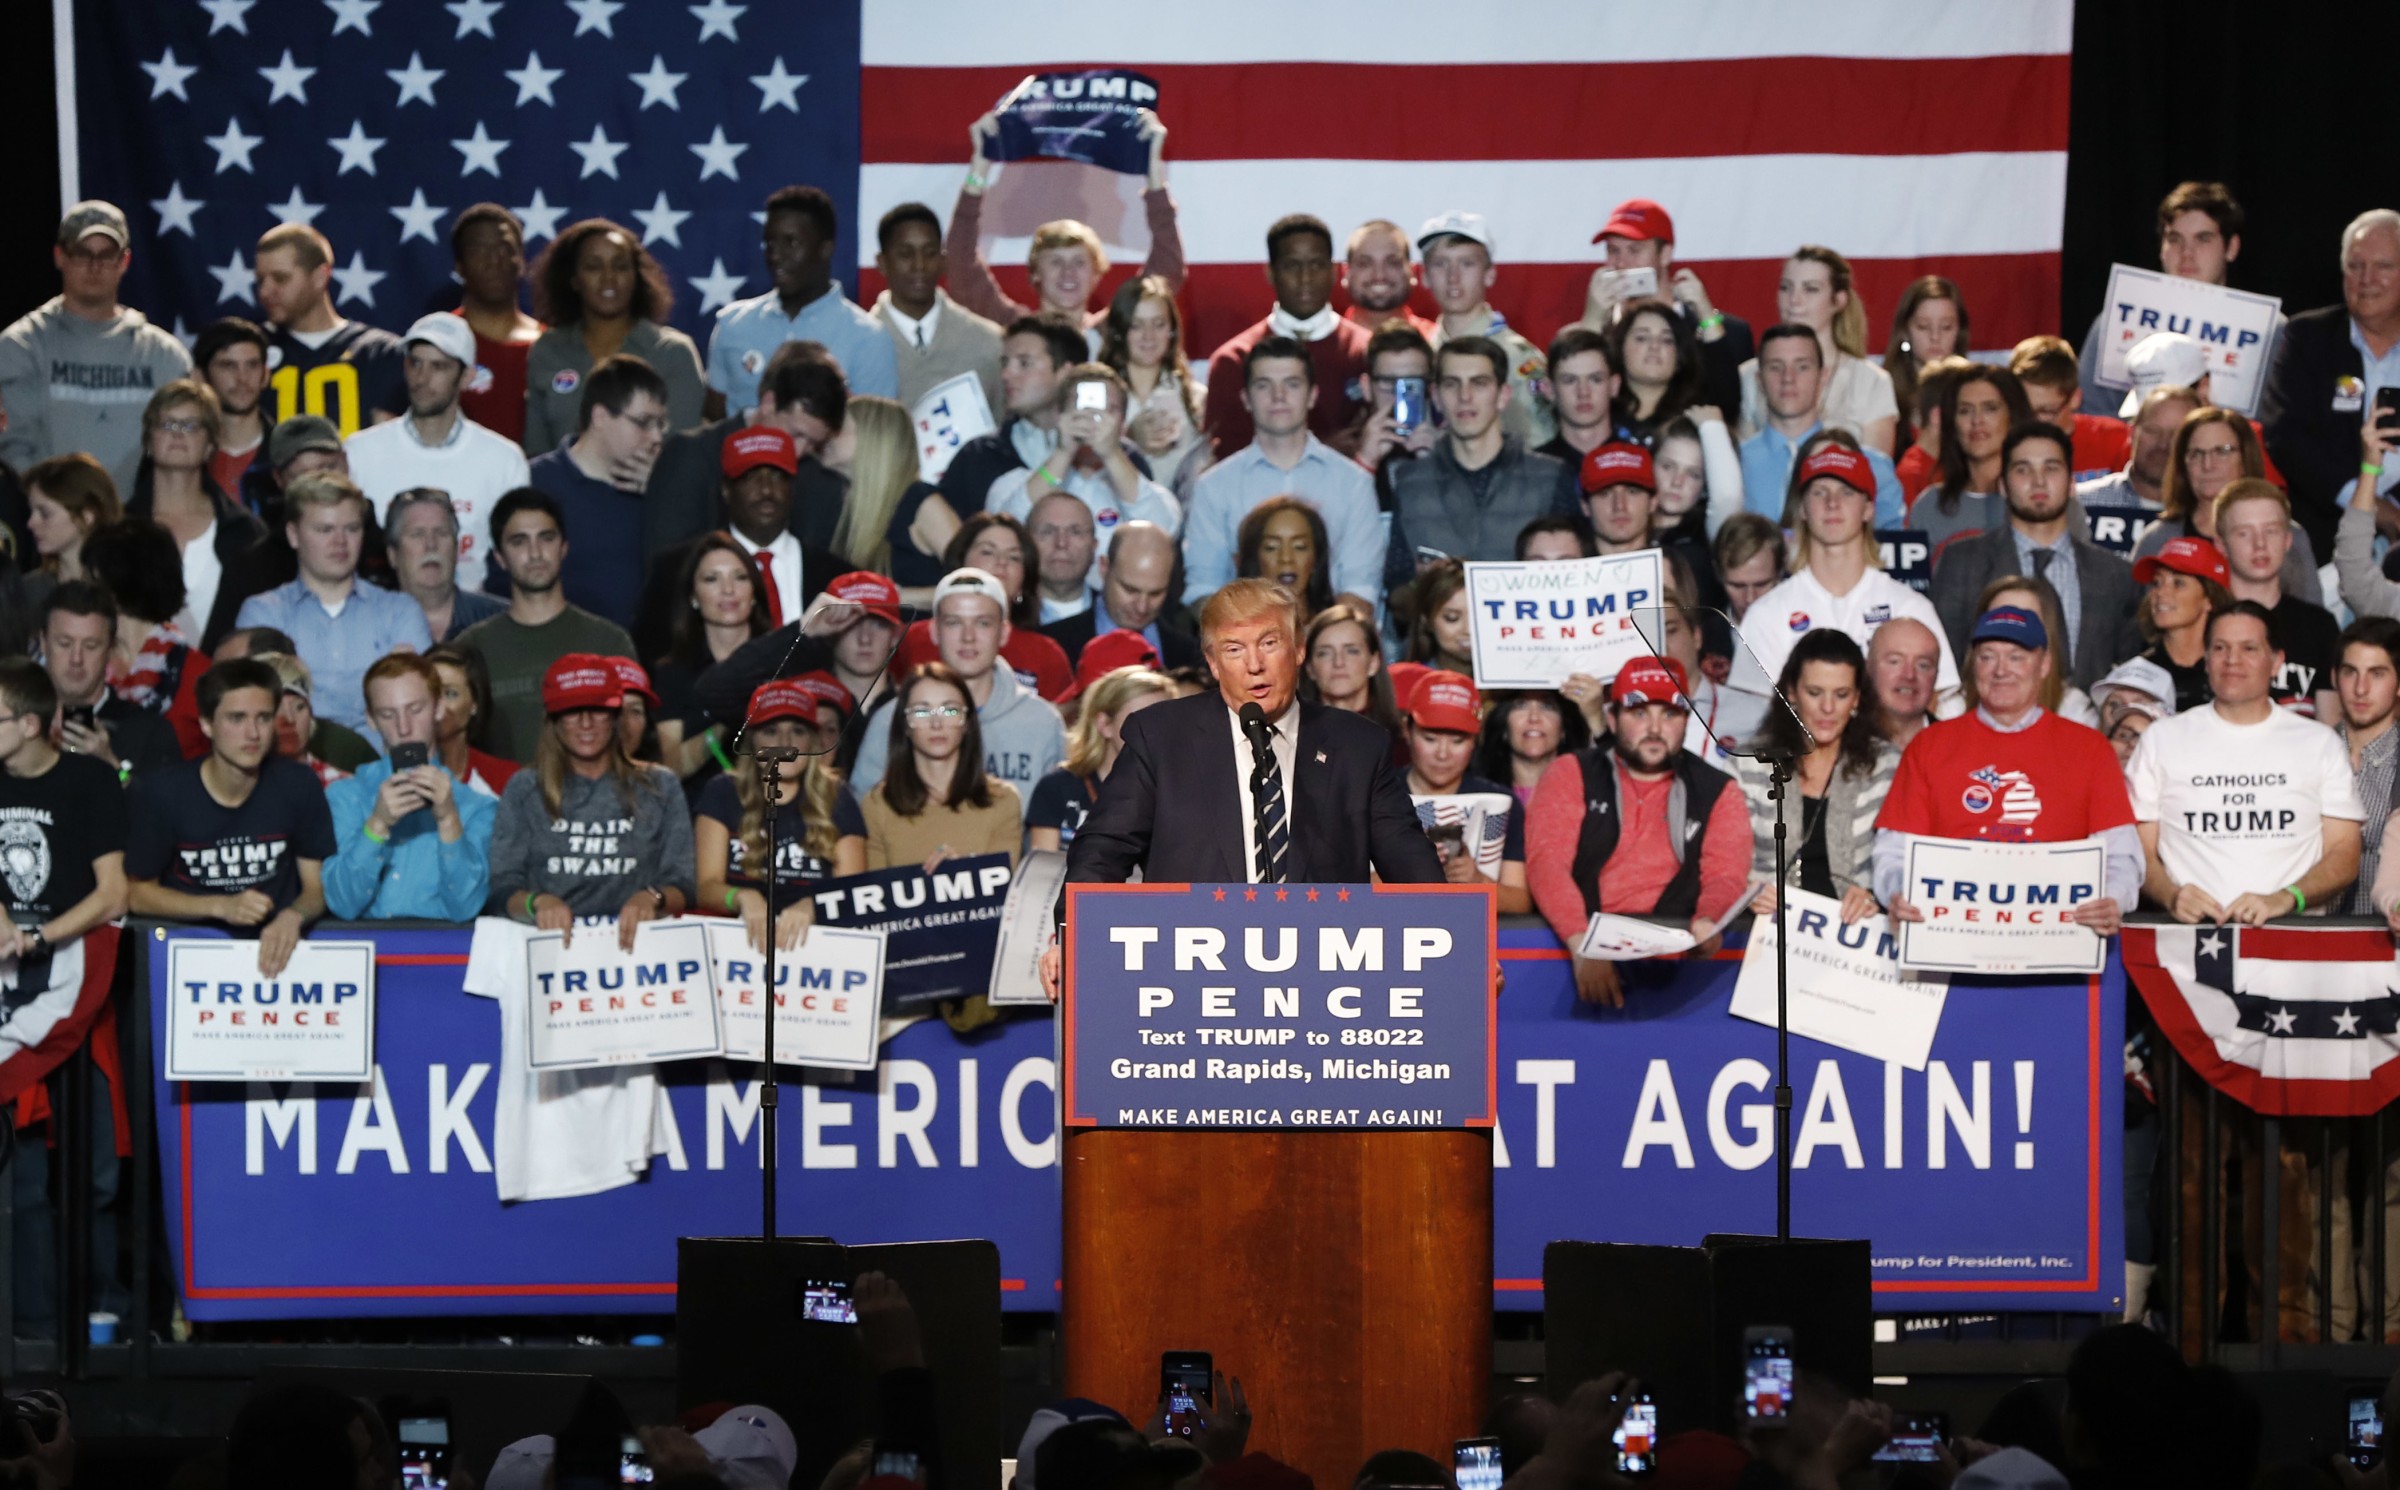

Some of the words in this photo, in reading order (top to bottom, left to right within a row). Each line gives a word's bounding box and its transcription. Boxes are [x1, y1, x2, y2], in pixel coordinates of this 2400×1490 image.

[1018, 76, 1158, 102] RUMP
[2117, 303, 2260, 348] TRUMP
[51, 360, 155, 389] MICHIGAN
[271, 363, 360, 441] 10
[2087, 515, 2148, 545] RU
[1501, 567, 1603, 591] WOMEN
[1483, 589, 1649, 620] TRUMP
[1500, 620, 1633, 640] PENCE
[2271, 662, 2316, 701] ry
[986, 751, 1032, 781] ALE
[2191, 773, 2287, 787] CATHOLICS
[2222, 793, 2256, 806] FOR
[550, 816, 635, 835] DRAIN
[2183, 809, 2296, 833] TRUMP
[180, 840, 287, 867] TRUMP
[568, 835, 619, 855] THE
[546, 856, 638, 877] SWAMP
[814, 865, 1013, 921] TRUMP
[1920, 877, 2094, 905] TRUMP
[923, 909, 967, 929] GREAT
[1933, 906, 2075, 924] PENCE
[1109, 926, 1453, 973] TRUMP
[537, 960, 701, 995] TRUMP
[713, 956, 869, 992] RUMP
[1792, 946, 1850, 972] AMERICA
[1853, 965, 1894, 984] GREAT
[183, 981, 359, 1006] TRUMP
[549, 989, 688, 1015] PENCE
[1138, 986, 1424, 1018] PENCE
[199, 1010, 341, 1027] PENCE
[1137, 1029, 1186, 1045] Text
[1195, 1028, 1296, 1046] TRUMP
[1305, 1030, 1331, 1046] to
[1339, 1028, 1424, 1046] 88022
[1110, 1057, 1196, 1079] Grand
[1206, 1058, 1312, 1084] Rapids,
[1322, 1058, 1451, 1085] Michigan
[246, 1063, 494, 1175] MAK
[668, 1057, 1057, 1171] MERIC
[1621, 1058, 2035, 1171] AGAIN!
[1118, 1108, 1178, 1125] MAKE
[1185, 1108, 1283, 1125] AMERICA
[1290, 1108, 1360, 1125] GREAT
[1366, 1108, 1443, 1125] AGAIN!
[1870, 1256, 1915, 1271] ump
[1918, 1255, 1943, 1268] for
[1947, 1255, 2037, 1269] President,
[2040, 1255, 2074, 1268] Inc.
